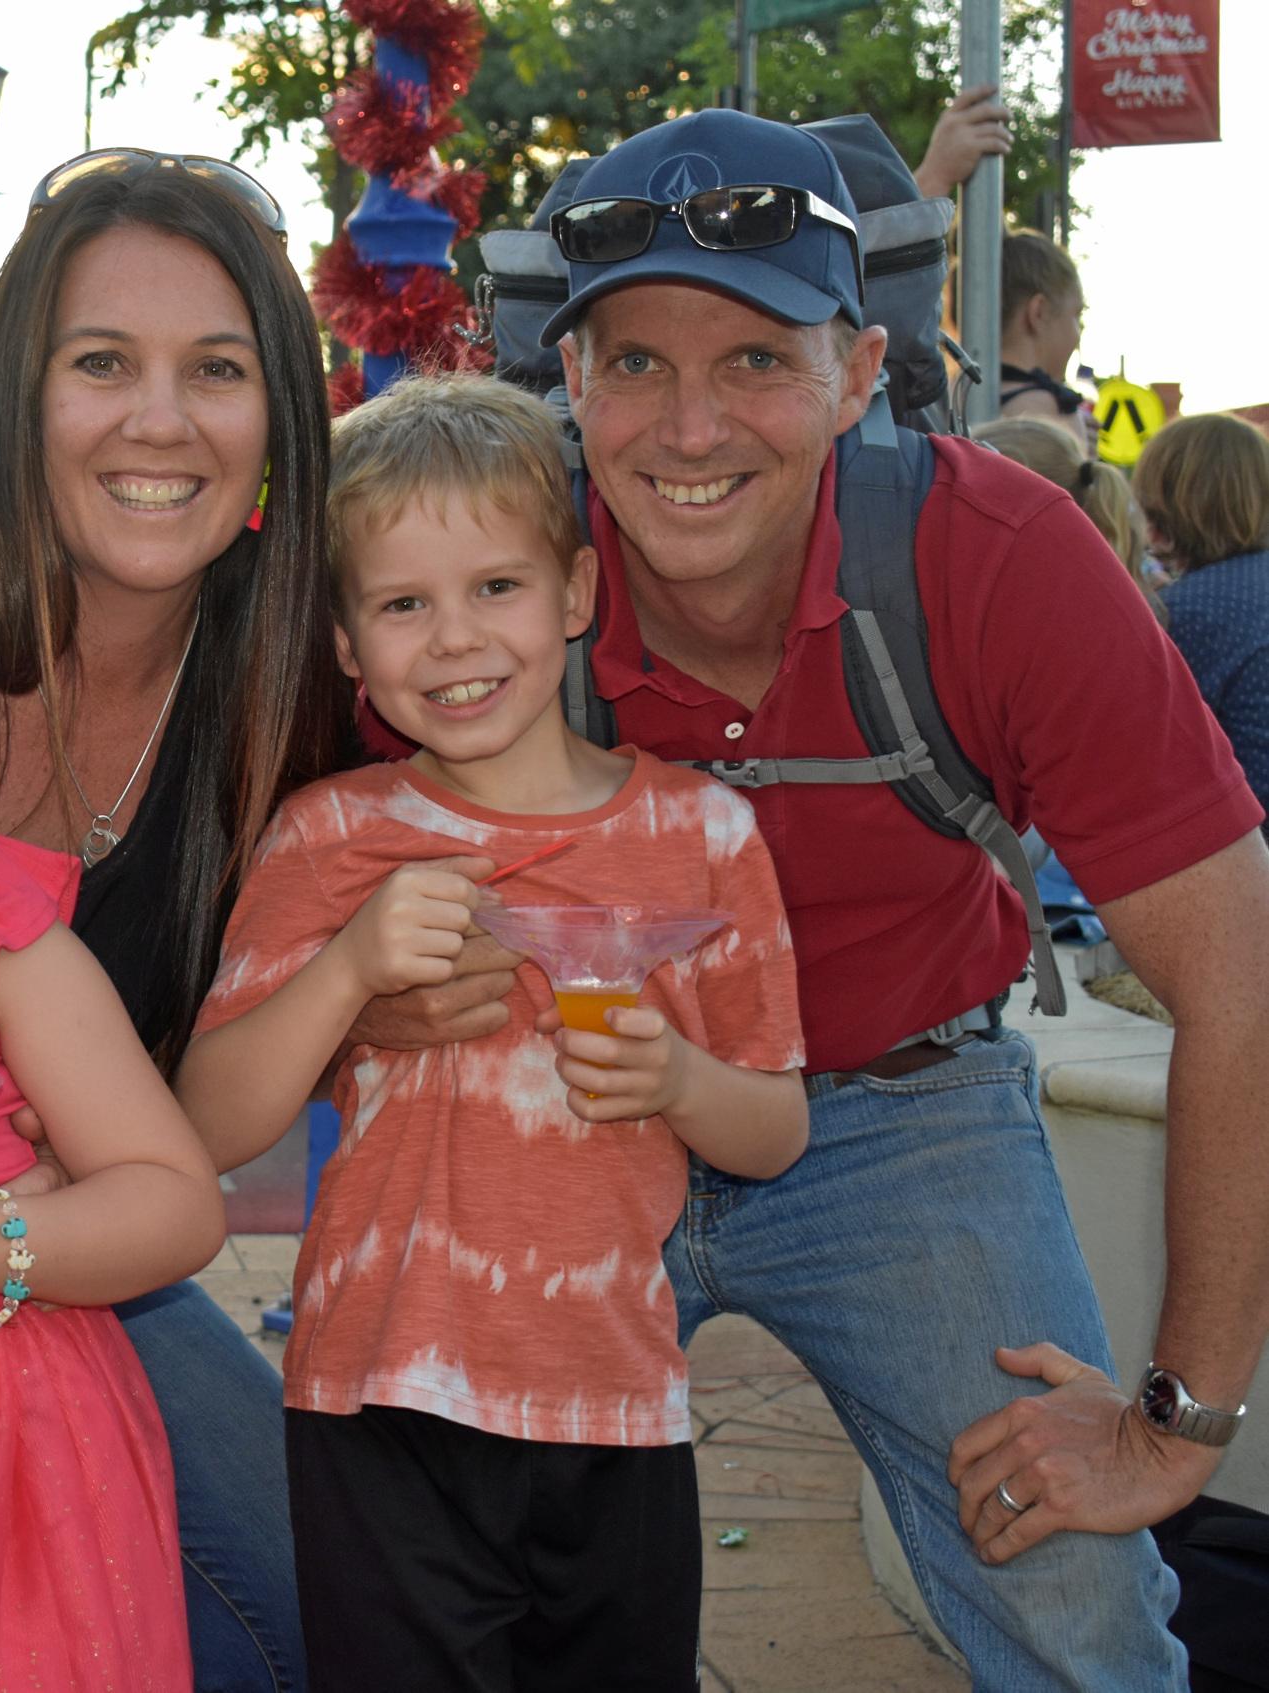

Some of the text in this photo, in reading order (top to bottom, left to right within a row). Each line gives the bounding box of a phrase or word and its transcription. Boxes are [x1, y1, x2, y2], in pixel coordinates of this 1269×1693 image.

[1105, 9, 1195, 35] Merry
[1087, 31, 1208, 60] Christmas
[1139, 56, 1156, 73] &
[1102, 70, 1187, 97] Happy
